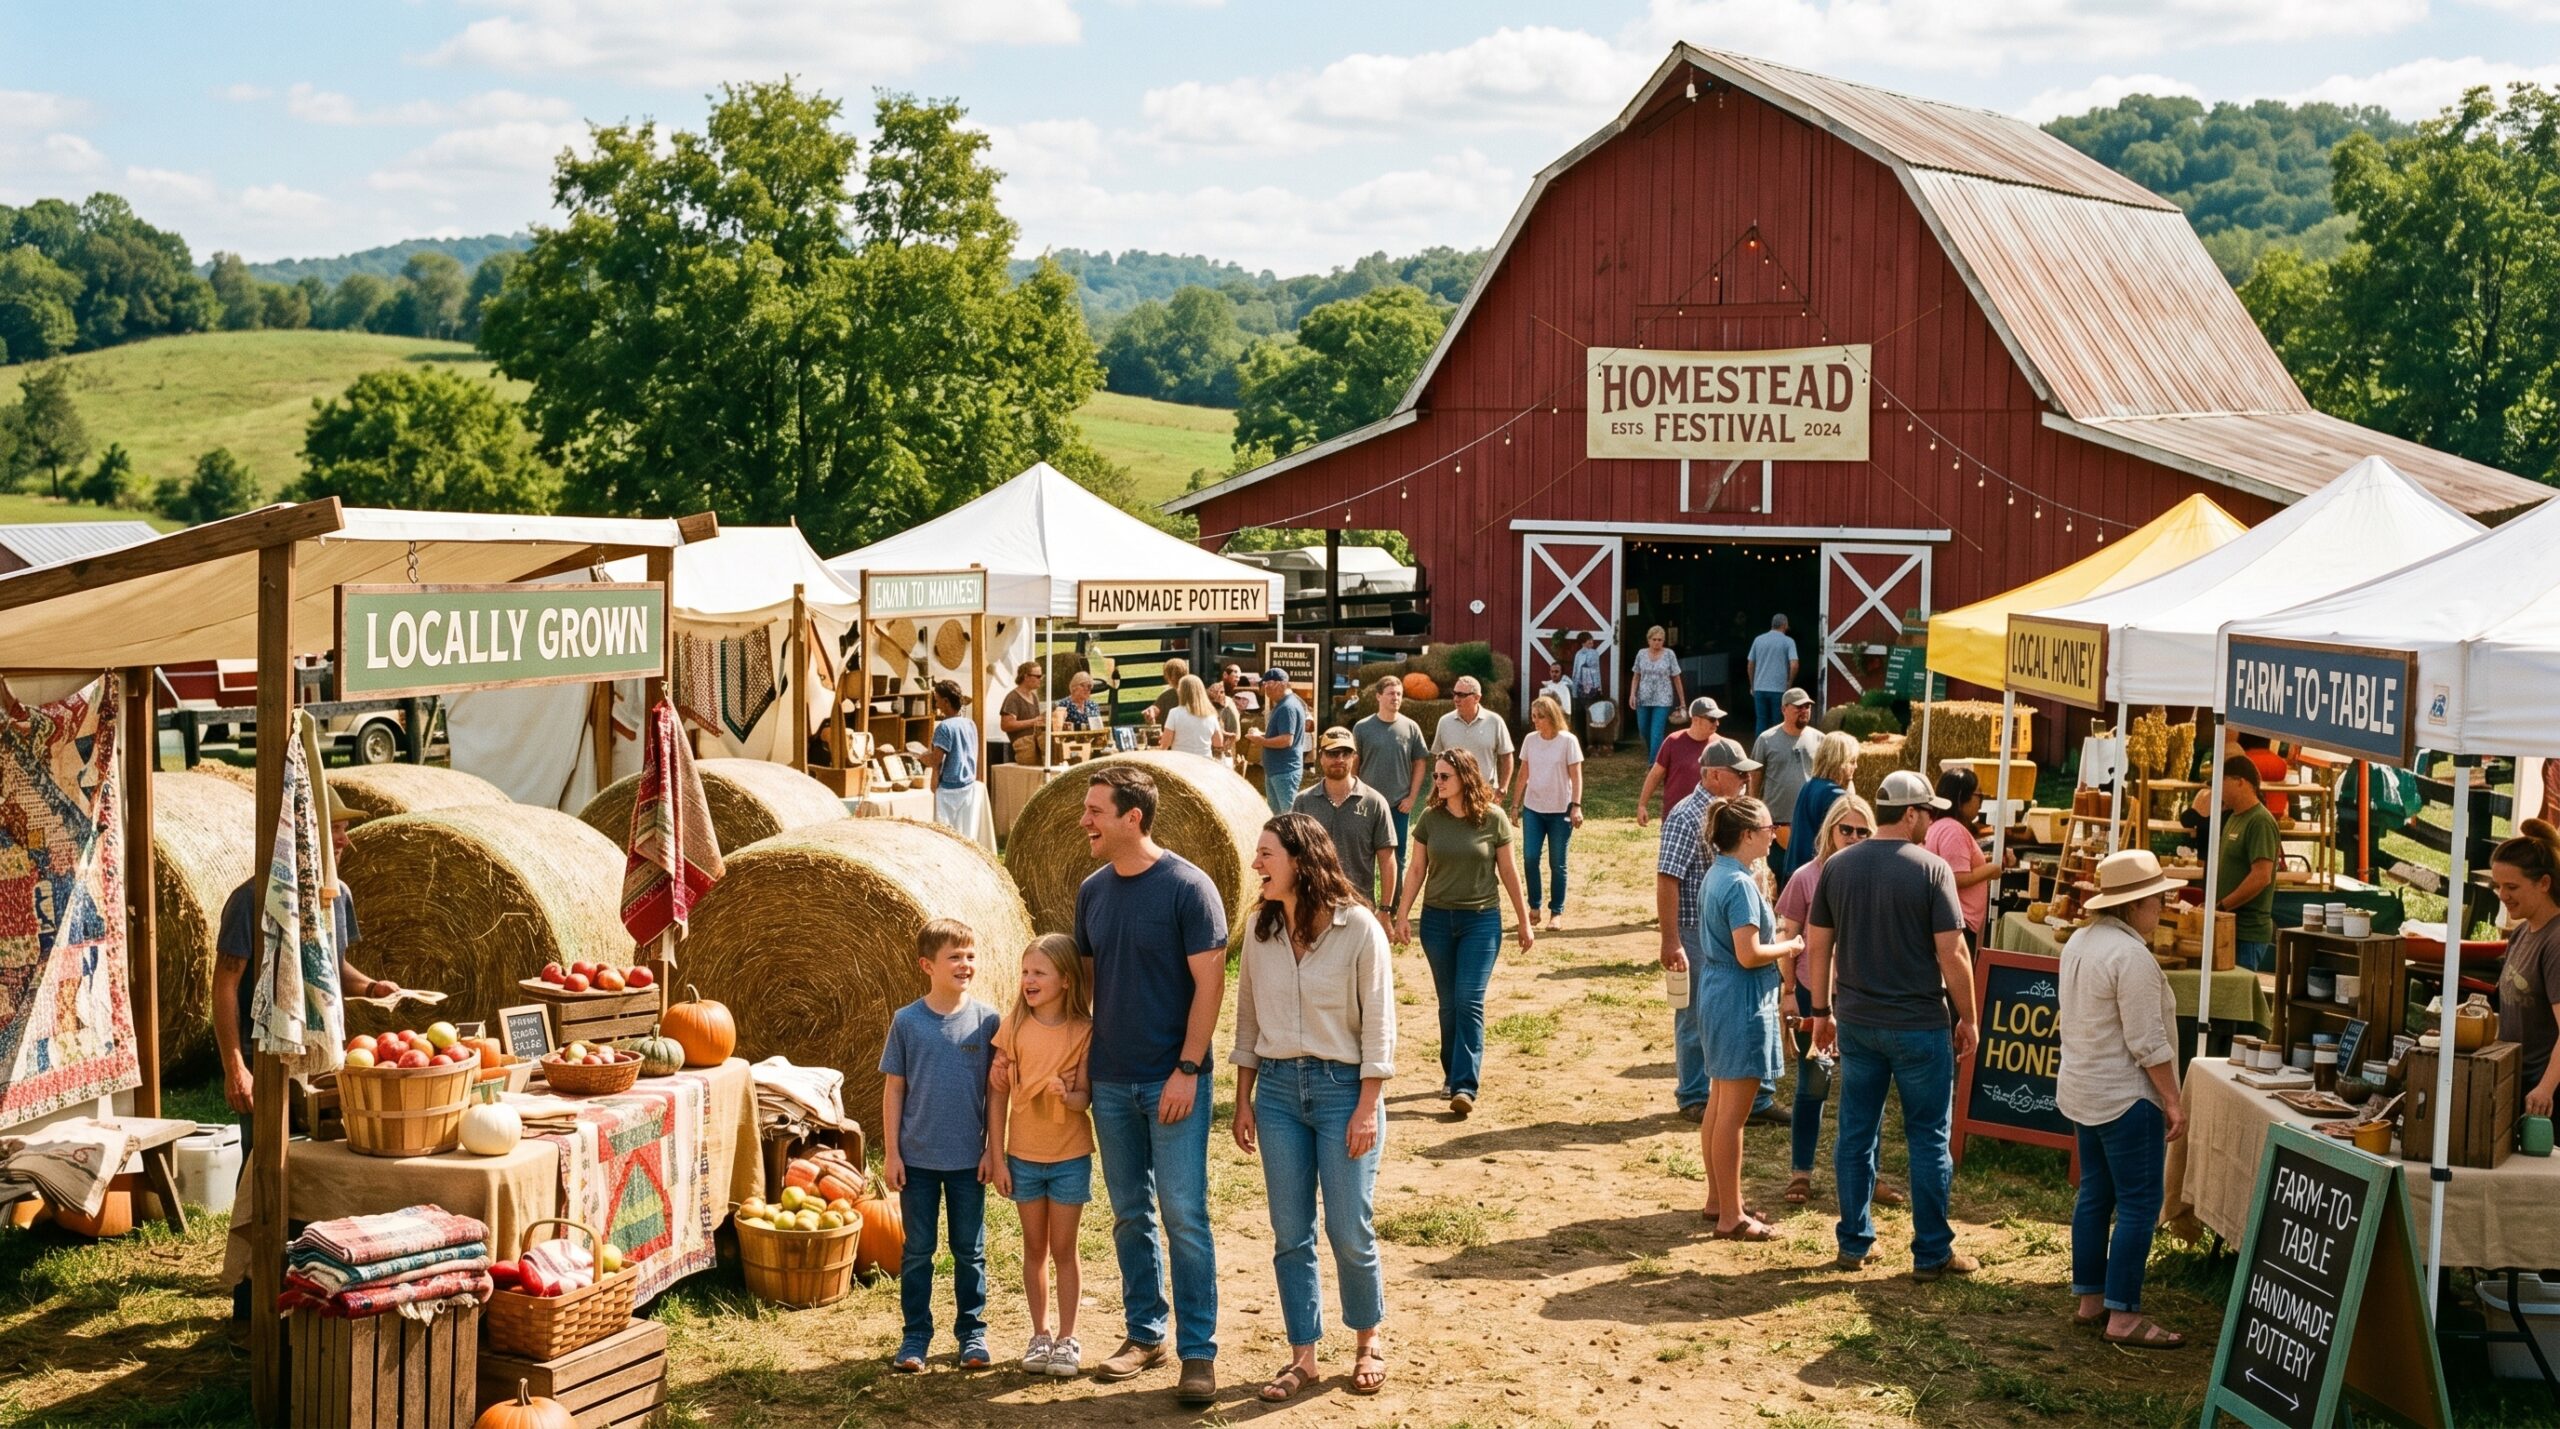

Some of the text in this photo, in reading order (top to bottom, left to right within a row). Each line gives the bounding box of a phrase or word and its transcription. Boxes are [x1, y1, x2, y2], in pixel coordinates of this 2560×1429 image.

[1602, 363, 1854, 414] HOMESTEAD
[1654, 412, 1796, 443] FESTIVAL
[1804, 423, 1842, 437] 2024
[1088, 588, 1260, 613] HANDMADE POTTERY
[366, 606, 648, 669] LOCALLY GROWN
[2012, 631, 2096, 690] LOCAL HONEY
[2234, 658, 2397, 736] FARM-TO-TABLE
[1992, 1000, 2062, 1039] LOCA
[1985, 1037, 2062, 1079] HONE
[2274, 1166, 2358, 1231] FARM-TO-
[2279, 1218, 2335, 1276] TABLE
[2248, 1273, 2334, 1346] HANDMADE
[2246, 1317, 2317, 1382] POTTERY
